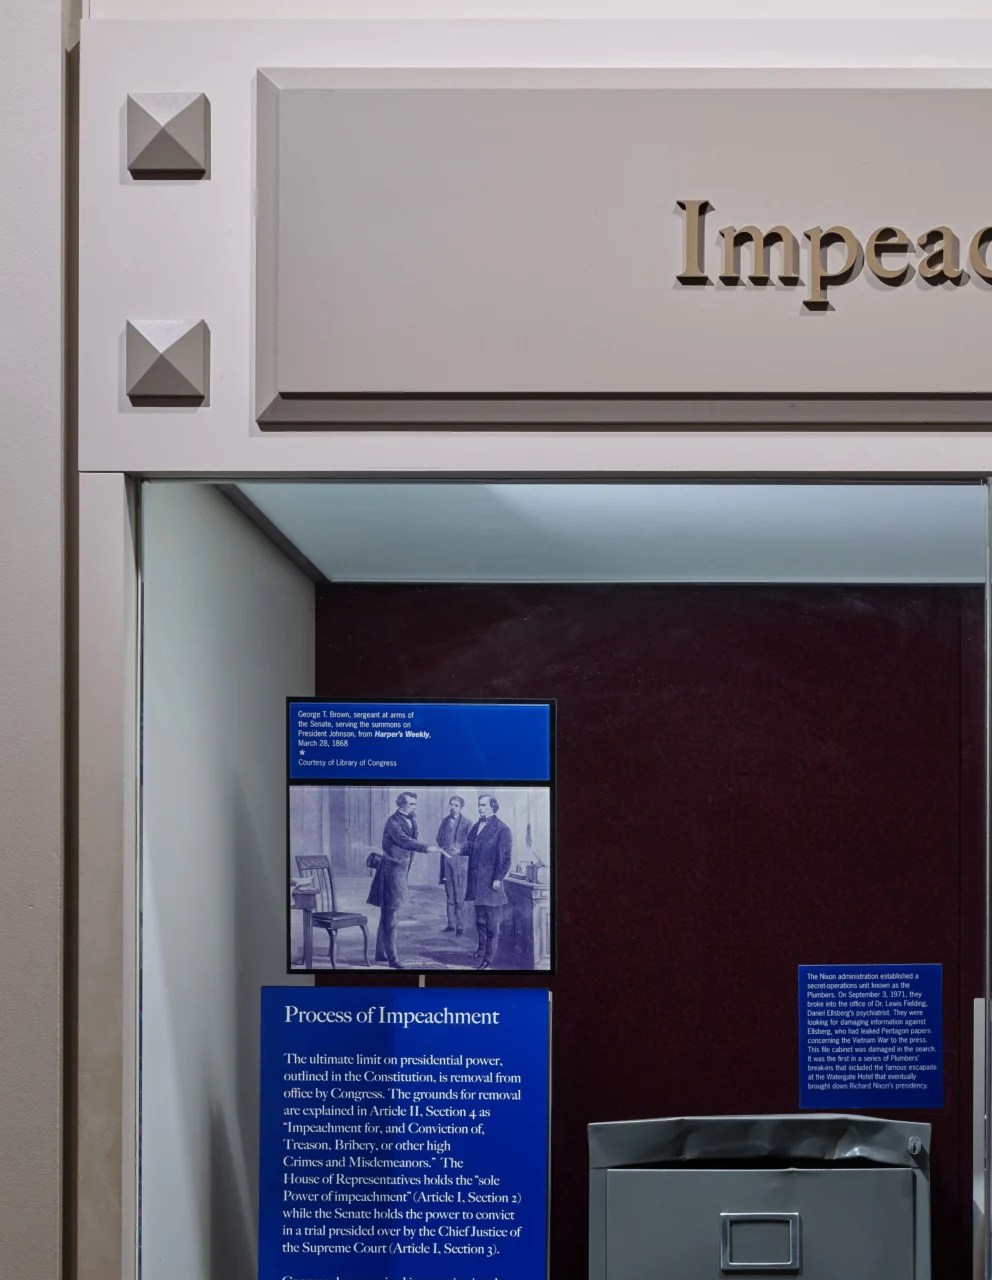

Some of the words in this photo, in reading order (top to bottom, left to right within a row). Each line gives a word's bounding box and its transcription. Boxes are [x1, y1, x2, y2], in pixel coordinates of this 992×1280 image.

[297, 710, 321, 721] George
[322, 710, 328, 718] T.
[329, 710, 352, 720] Brown,
[353, 710, 381, 721] sergeant
[381, 710, 389, 718] at
[407, 710, 415, 718] of
[297, 720, 309, 728] the
[309, 720, 334, 729] Senate,
[335, 720, 358, 730] serving
[359, 720, 370, 728] the
[297, 729, 328, 738] President
[328, 730, 357, 739] Johnson,
[357, 730, 373, 738] from
[404, 730, 432, 740] Weekly,
[297, 739, 318, 747] March
[319, 739, 330, 748] 28,
[332, 739, 349, 747] 1868
[298, 758, 327, 768] Courtesy
[327, 758, 335, 766] of
[335, 758, 358, 768] Library
[359, 758, 366, 766] of
[367, 758, 398, 769] Congress
[807, 972, 819, 980] The
[819, 972, 837, 980] Nixon
[837, 972, 879, 980] administration
[879, 972, 914, 980] established
[807, 981, 858, 991] secret-operations
[858, 981, 870, 989] unit
[870, 981, 891, 989] known
[900, 981, 911, 989] the
[285, 1005, 353, 1023] Process
[356, 1005, 376, 1024] of
[379, 1005, 500, 1028] Impeachment
[283, 1052, 307, 1065] The
[309, 1052, 354, 1065] ultimate
[356, 1052, 382, 1065] limit
[383, 1056, 398, 1065] on
[400, 1052, 463, 1069] presidential
[465, 1056, 503, 1069] power,
